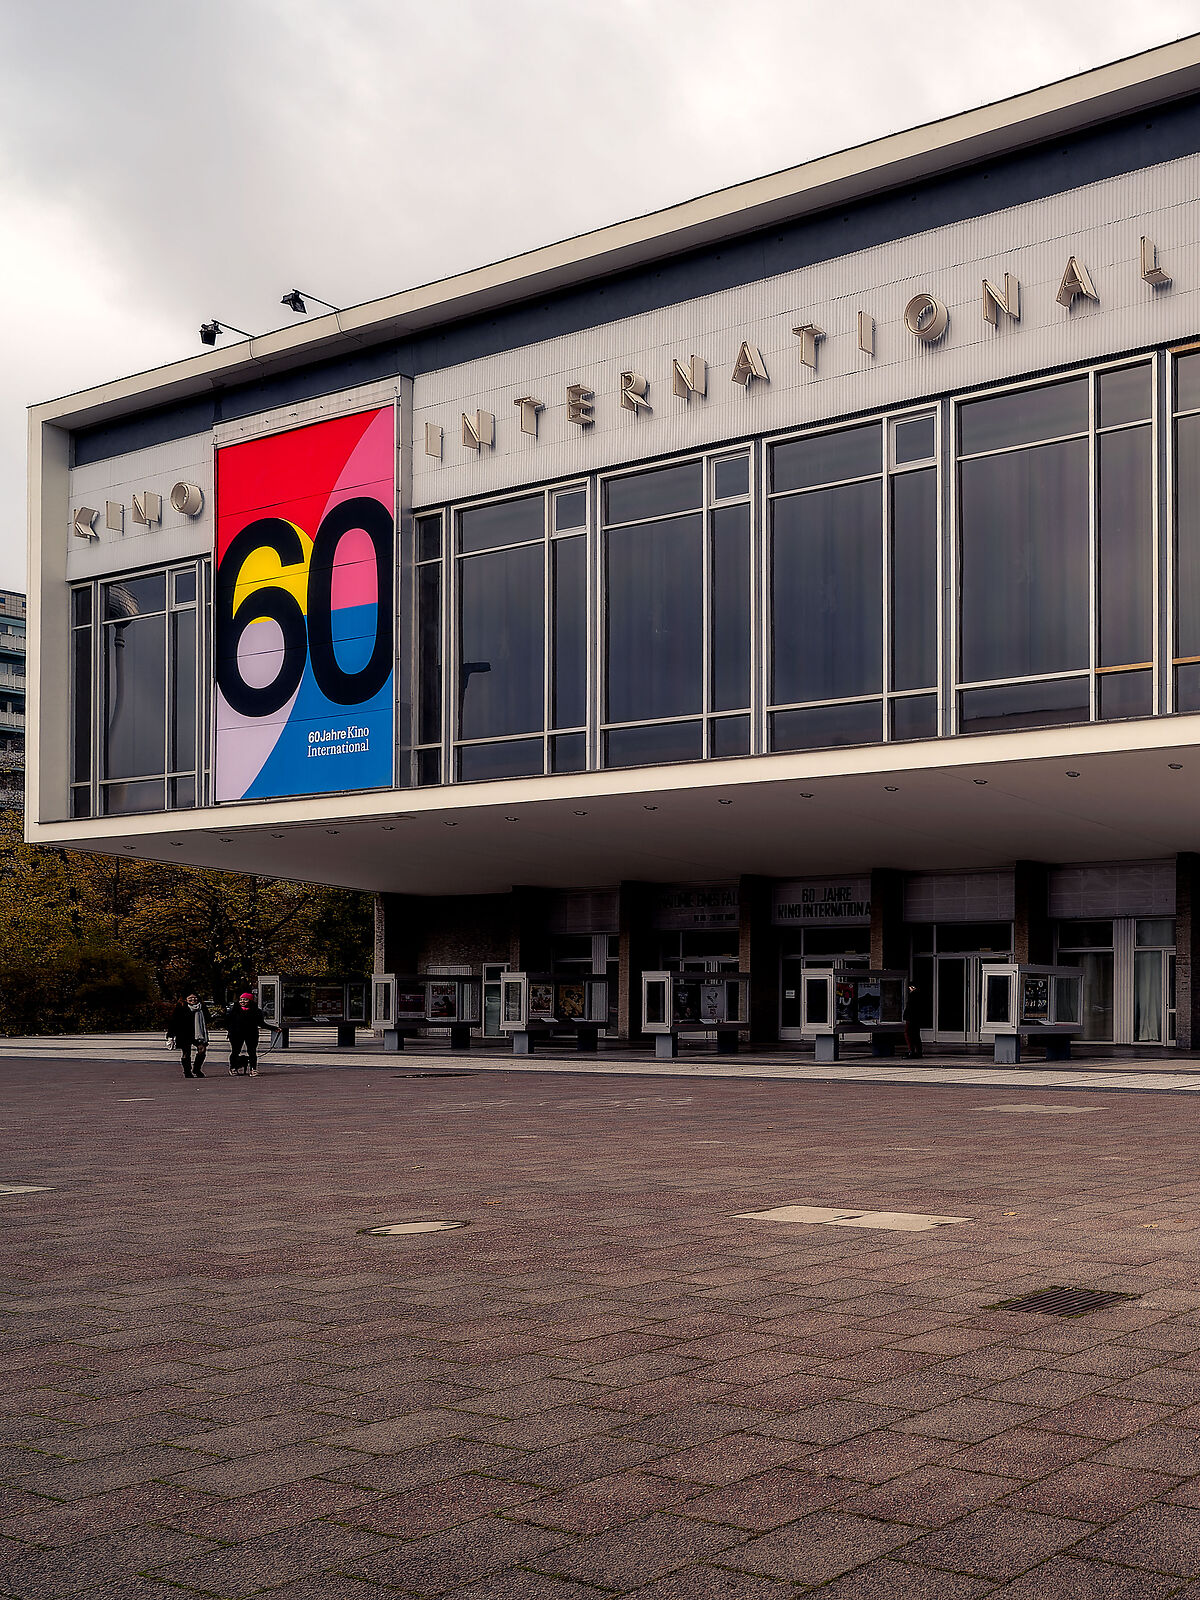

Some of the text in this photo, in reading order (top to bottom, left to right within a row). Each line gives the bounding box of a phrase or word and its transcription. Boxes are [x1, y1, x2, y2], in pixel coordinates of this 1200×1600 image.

[425, 235, 1173, 459] INTERNATIONAL
[74, 481, 203, 541] KINO
[217, 496, 395, 718] 60
[308, 725, 370, 743] 60 Jahre Kino
[307, 738, 370, 758] International
[820, 886, 852, 902] JAHRE
[777, 903, 801, 918] KINO
